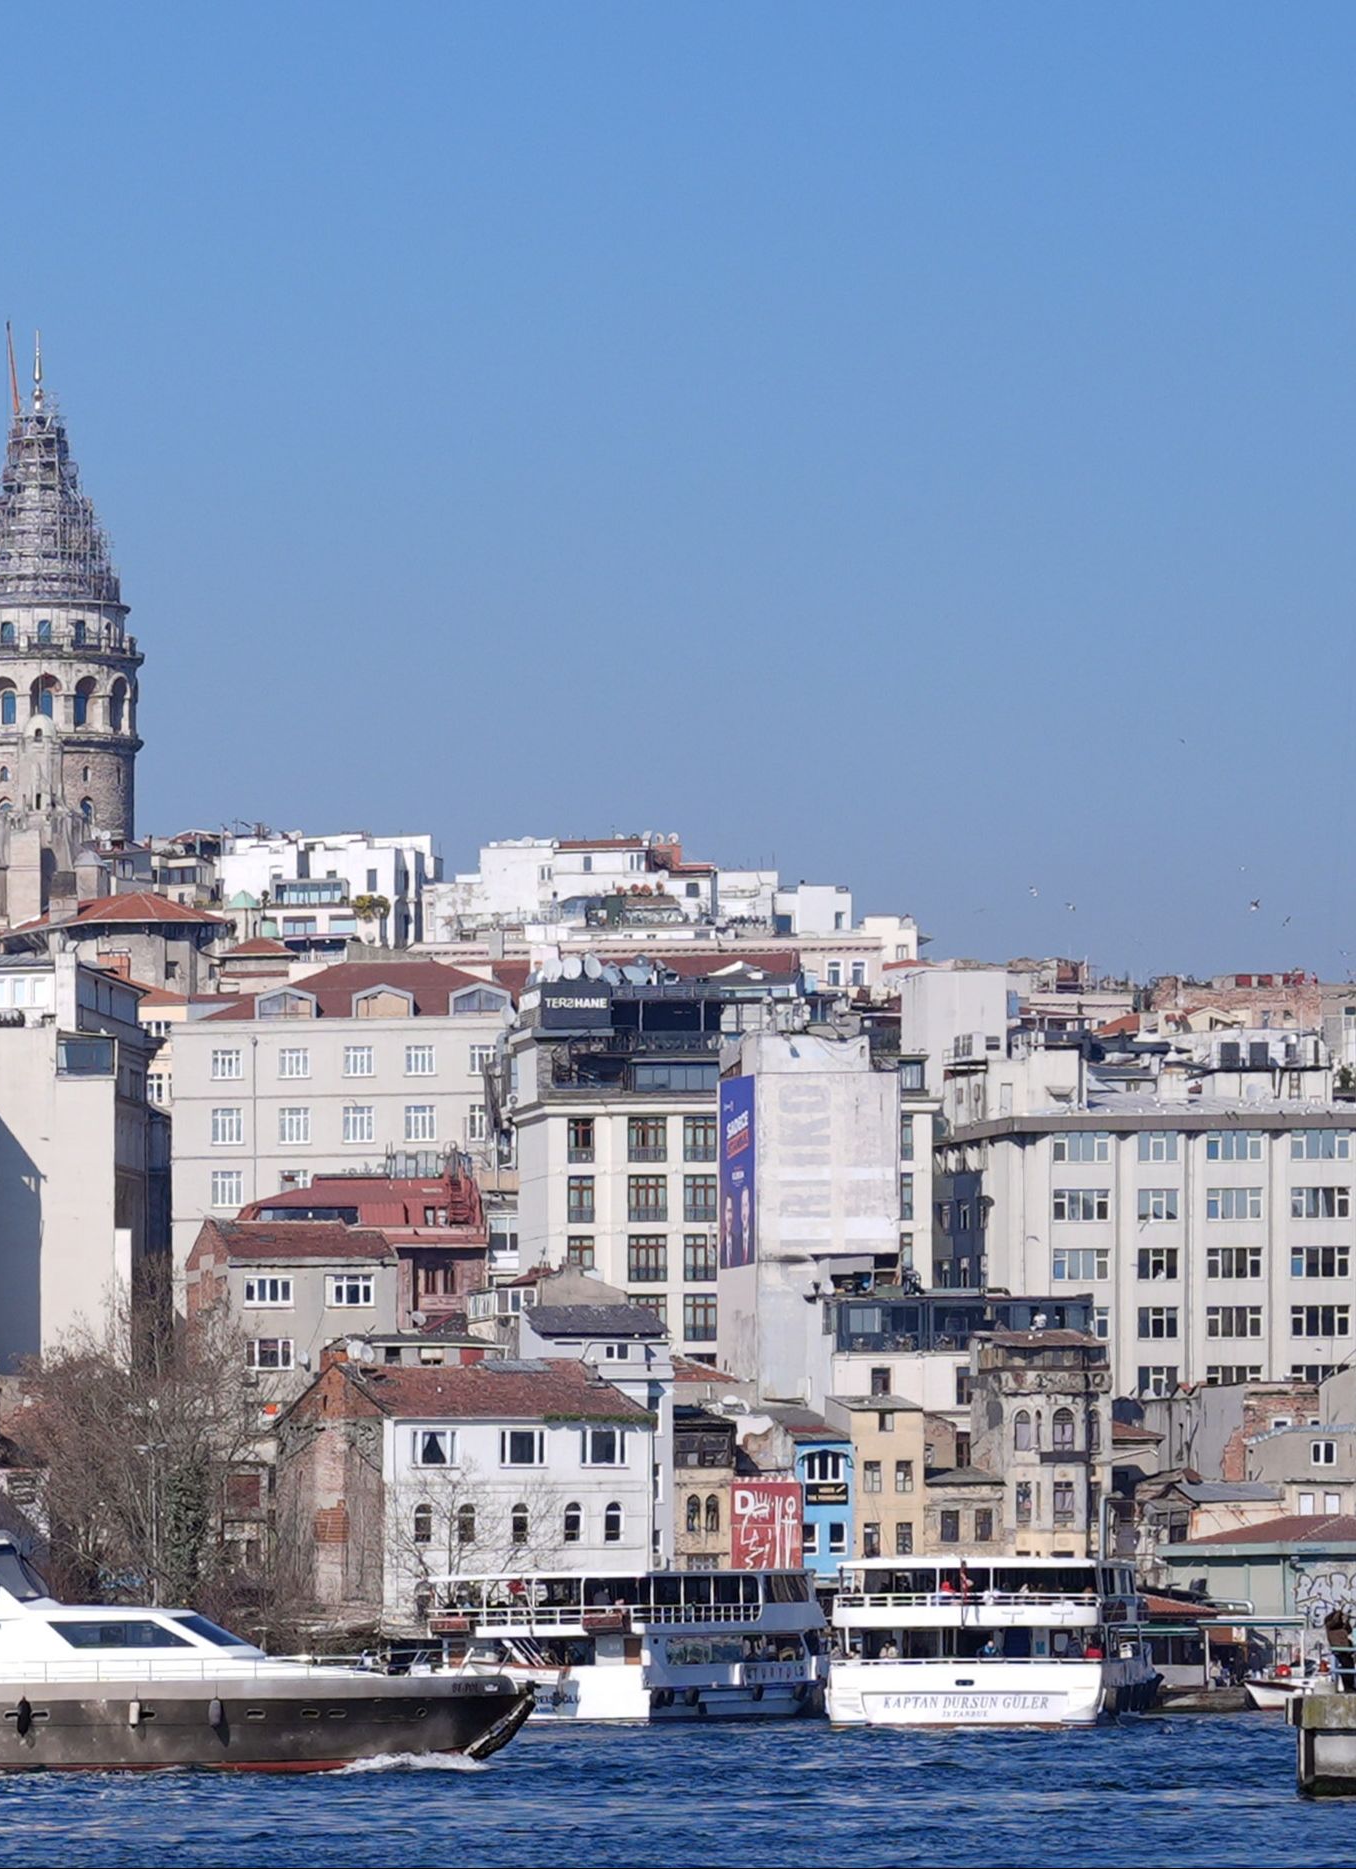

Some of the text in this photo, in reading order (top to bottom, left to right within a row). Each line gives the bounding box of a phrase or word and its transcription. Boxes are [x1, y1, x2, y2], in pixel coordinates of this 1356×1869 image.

[545, 997, 607, 1008] TERSHANE
[883, 1696, 938, 1709] KAPTAN
[942, 1696, 999, 1709] DURSUN
